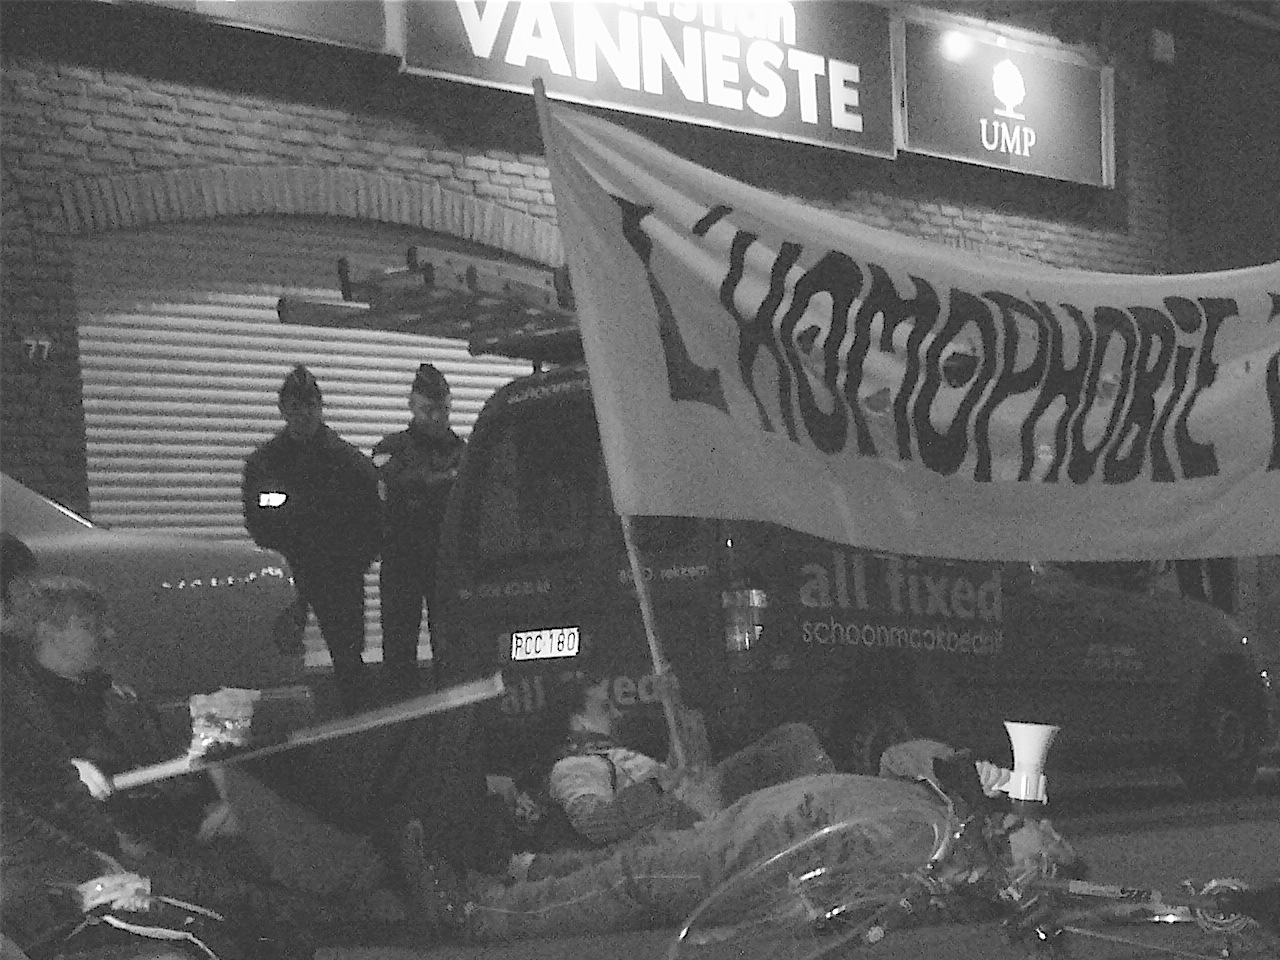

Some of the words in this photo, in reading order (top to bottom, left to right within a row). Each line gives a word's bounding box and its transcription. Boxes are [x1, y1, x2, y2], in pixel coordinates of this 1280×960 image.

[456, 0, 863, 133] VANNESTE
[980, 118, 1036, 157] UMP
[799, 550, 869, 610] all
